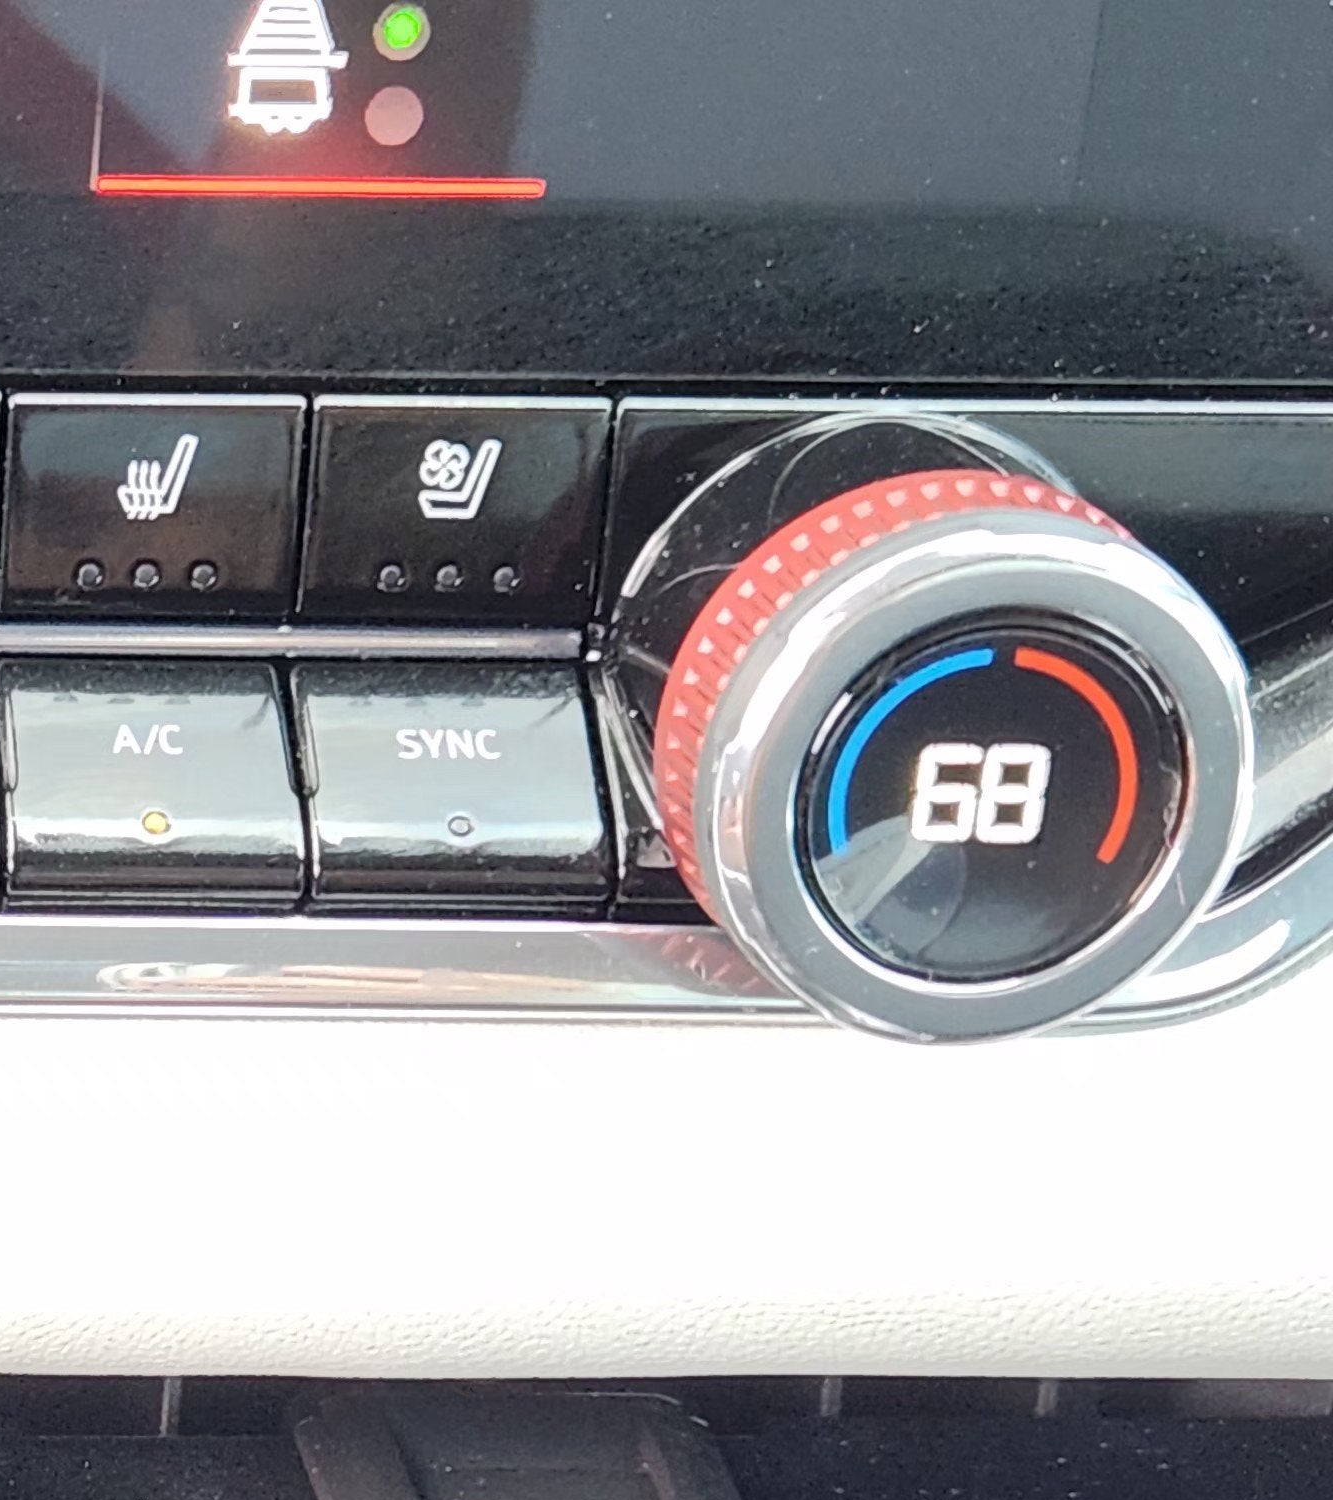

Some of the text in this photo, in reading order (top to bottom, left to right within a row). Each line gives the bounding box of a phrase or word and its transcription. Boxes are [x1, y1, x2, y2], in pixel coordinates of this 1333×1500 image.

[111, 722, 185, 758] A/C
[395, 726, 503, 761] SYNC
[910, 741, 1053, 844] 68
